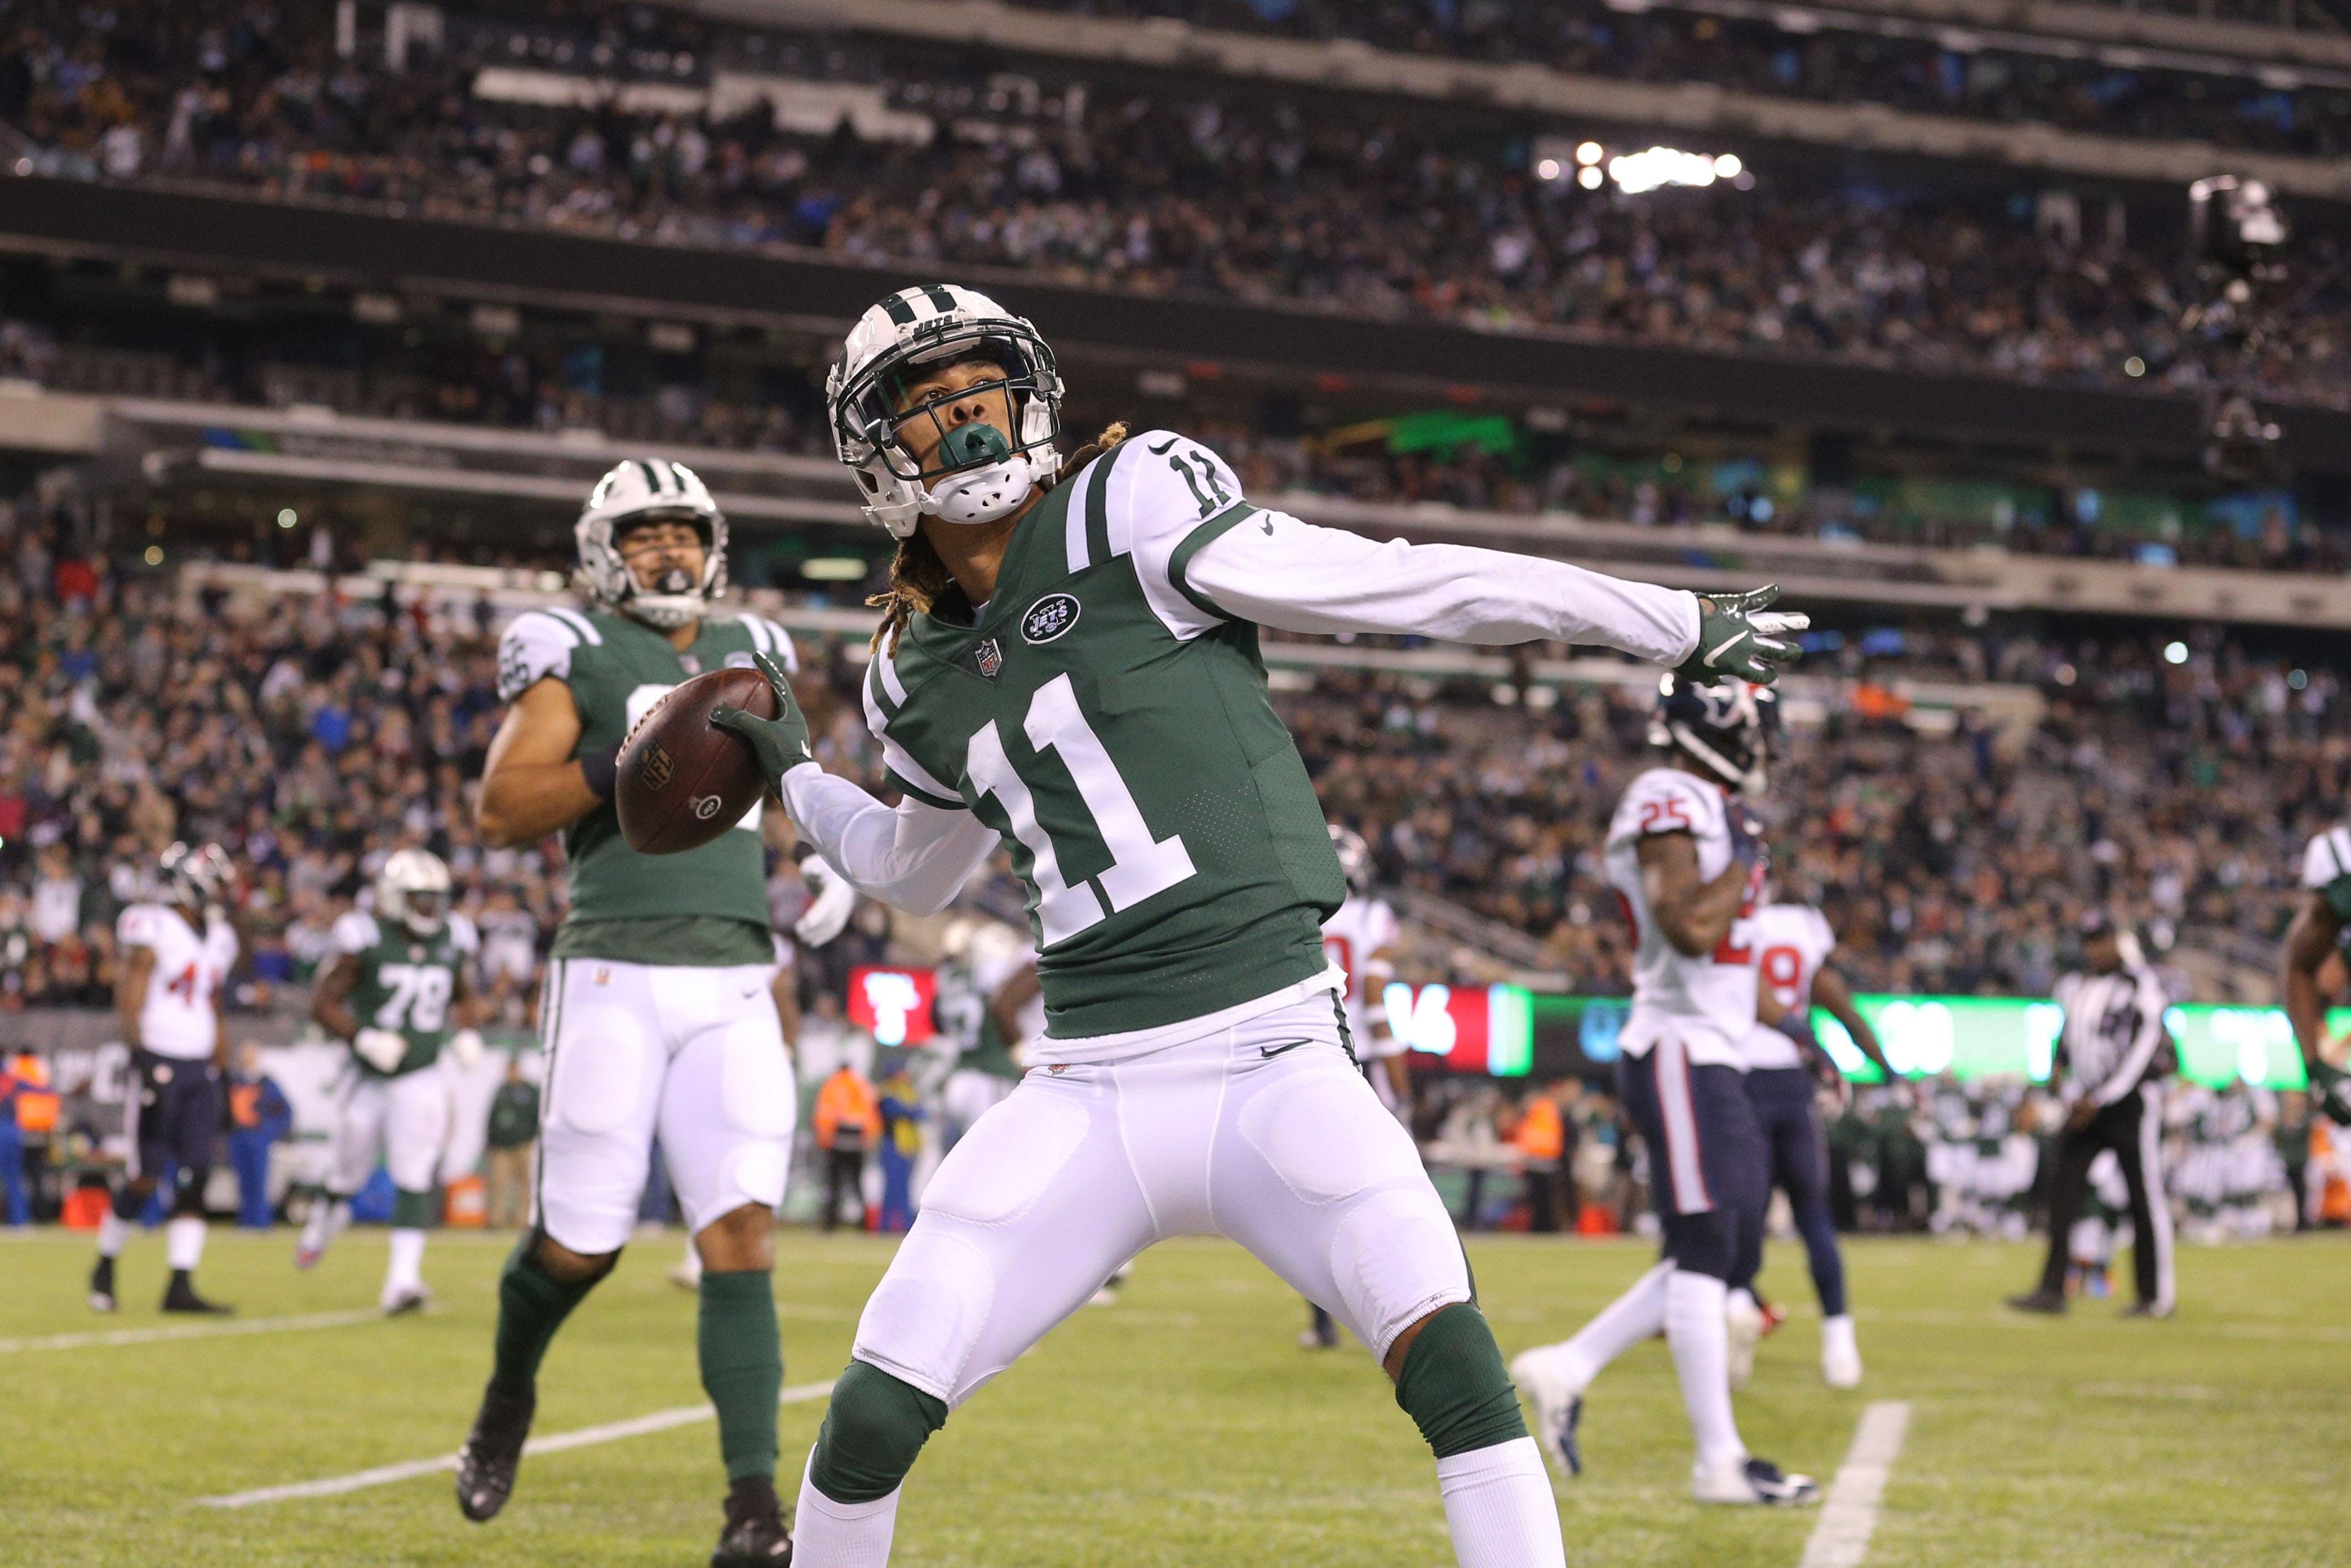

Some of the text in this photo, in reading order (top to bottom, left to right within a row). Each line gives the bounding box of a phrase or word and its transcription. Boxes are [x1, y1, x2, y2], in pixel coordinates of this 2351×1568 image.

[913, 314, 953, 335] JETS
[1169, 450, 1231, 519] 11
[1029, 605, 1068, 633] JETS
[642, 748, 674, 789] NFL
[967, 672, 1198, 948] 11
[1640, 798, 1692, 830] 25
